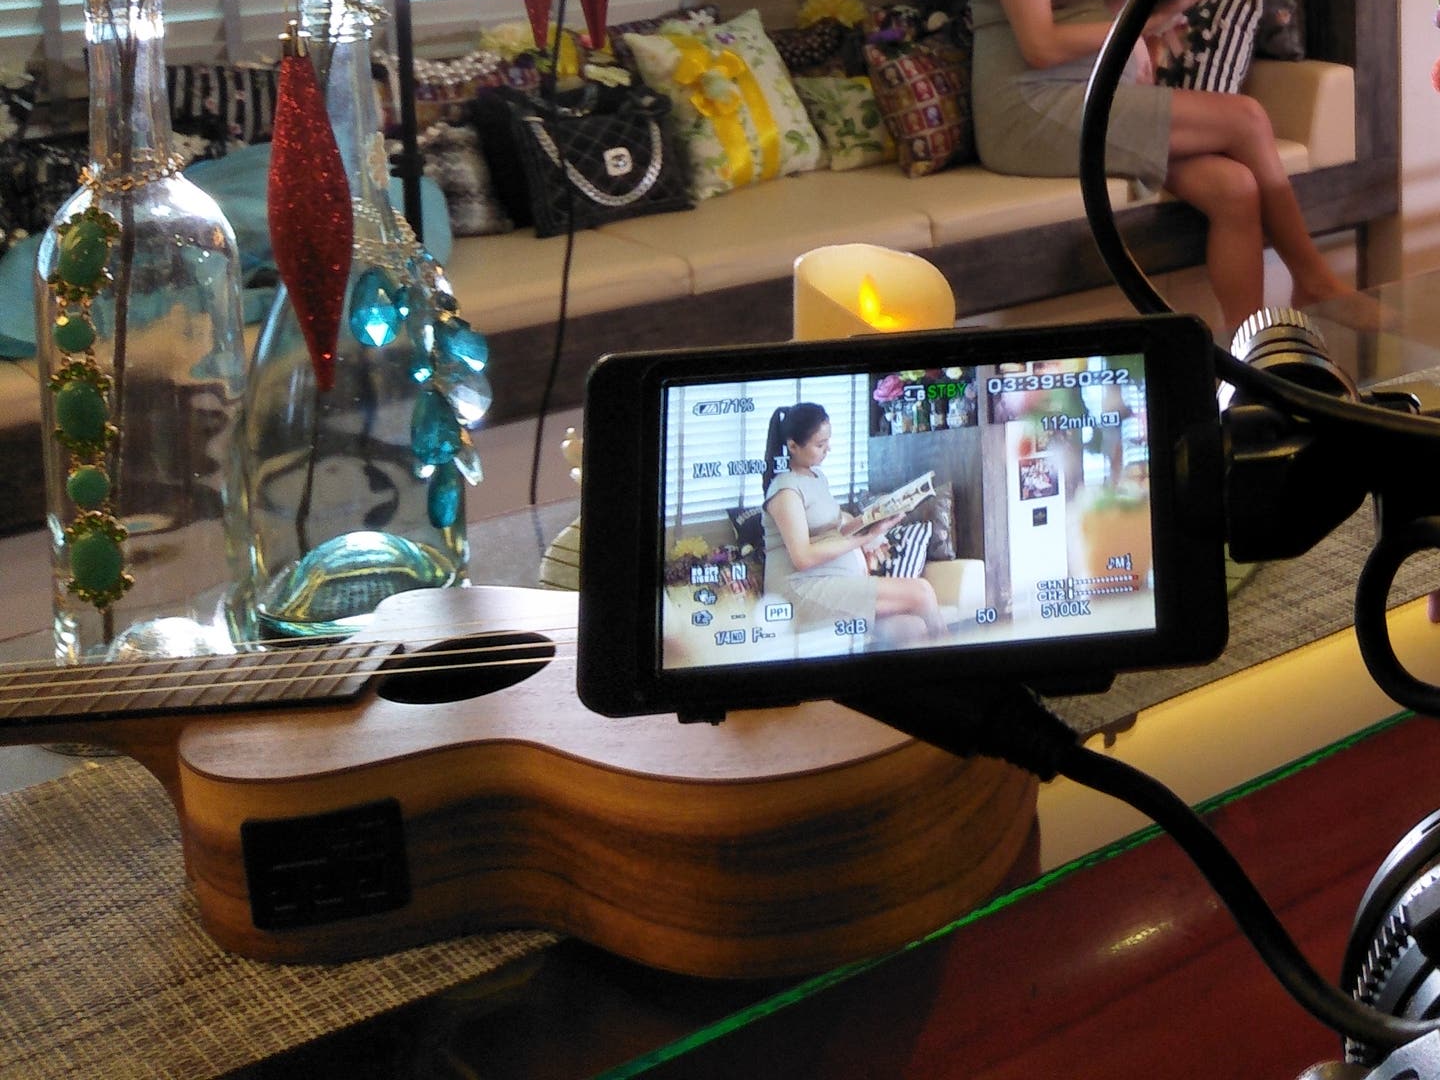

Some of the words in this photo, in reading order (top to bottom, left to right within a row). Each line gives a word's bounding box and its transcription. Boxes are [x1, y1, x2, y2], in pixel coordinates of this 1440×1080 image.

[987, 369, 1130, 395] 03:39:50:22
[926, 382, 968, 400] STBY
[721, 397, 755, 414] 71%
[693, 461, 722, 479] XAVC
[1036, 579, 1066, 592] CH1
[1036, 590, 1067, 602] CH2
[976, 607, 997, 624] 50
[1041, 602, 1091, 619] 5100K
[835, 618, 868, 636] 3dB
